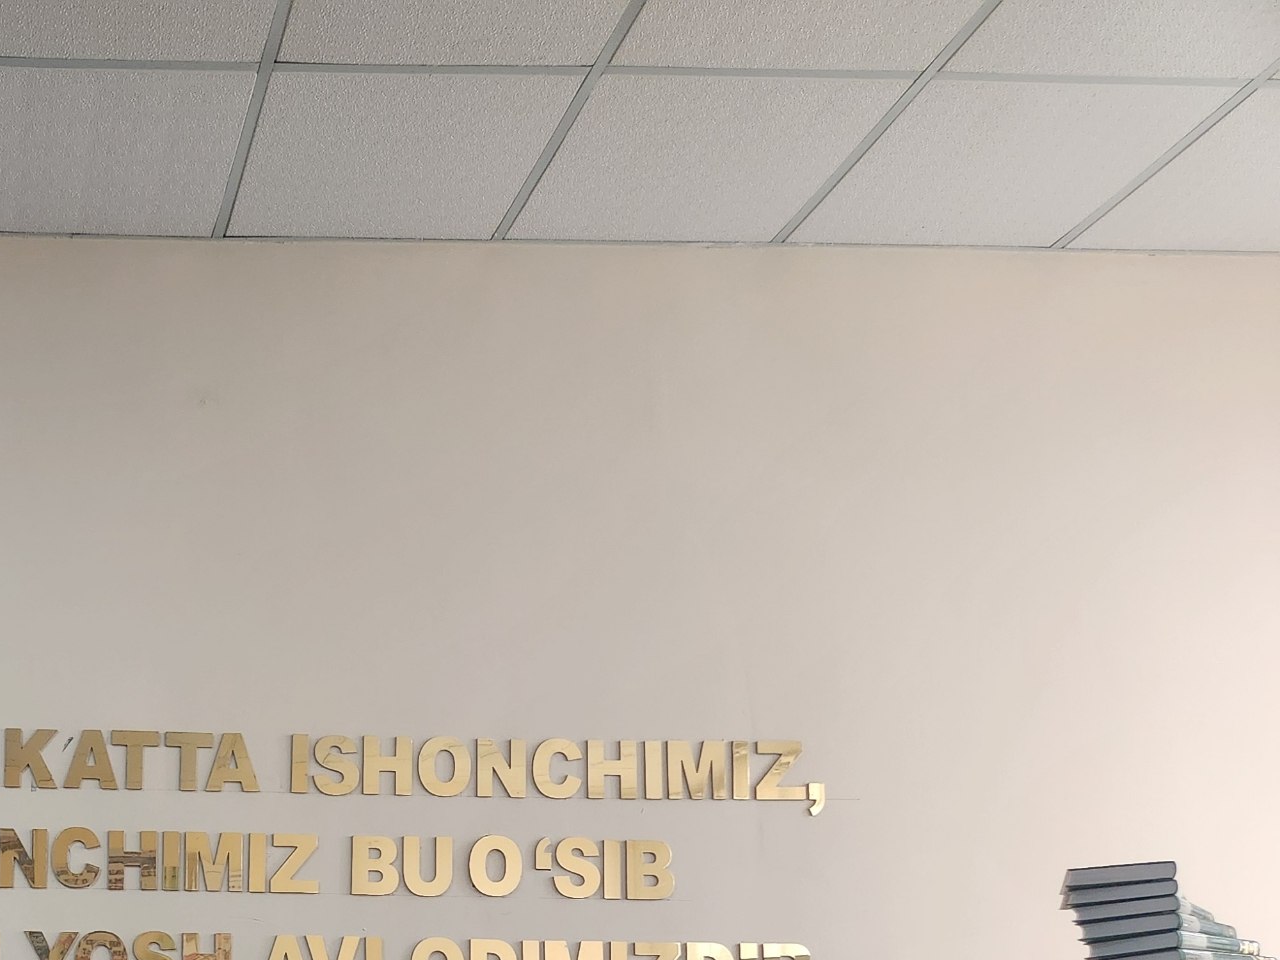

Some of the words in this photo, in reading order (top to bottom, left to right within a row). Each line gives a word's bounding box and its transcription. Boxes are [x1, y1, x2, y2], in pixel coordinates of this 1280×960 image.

[3, 727, 261, 792] KATTA
[290, 734, 826, 816] ISHONCHIMIZ,
[351, 835, 454, 896] BU
